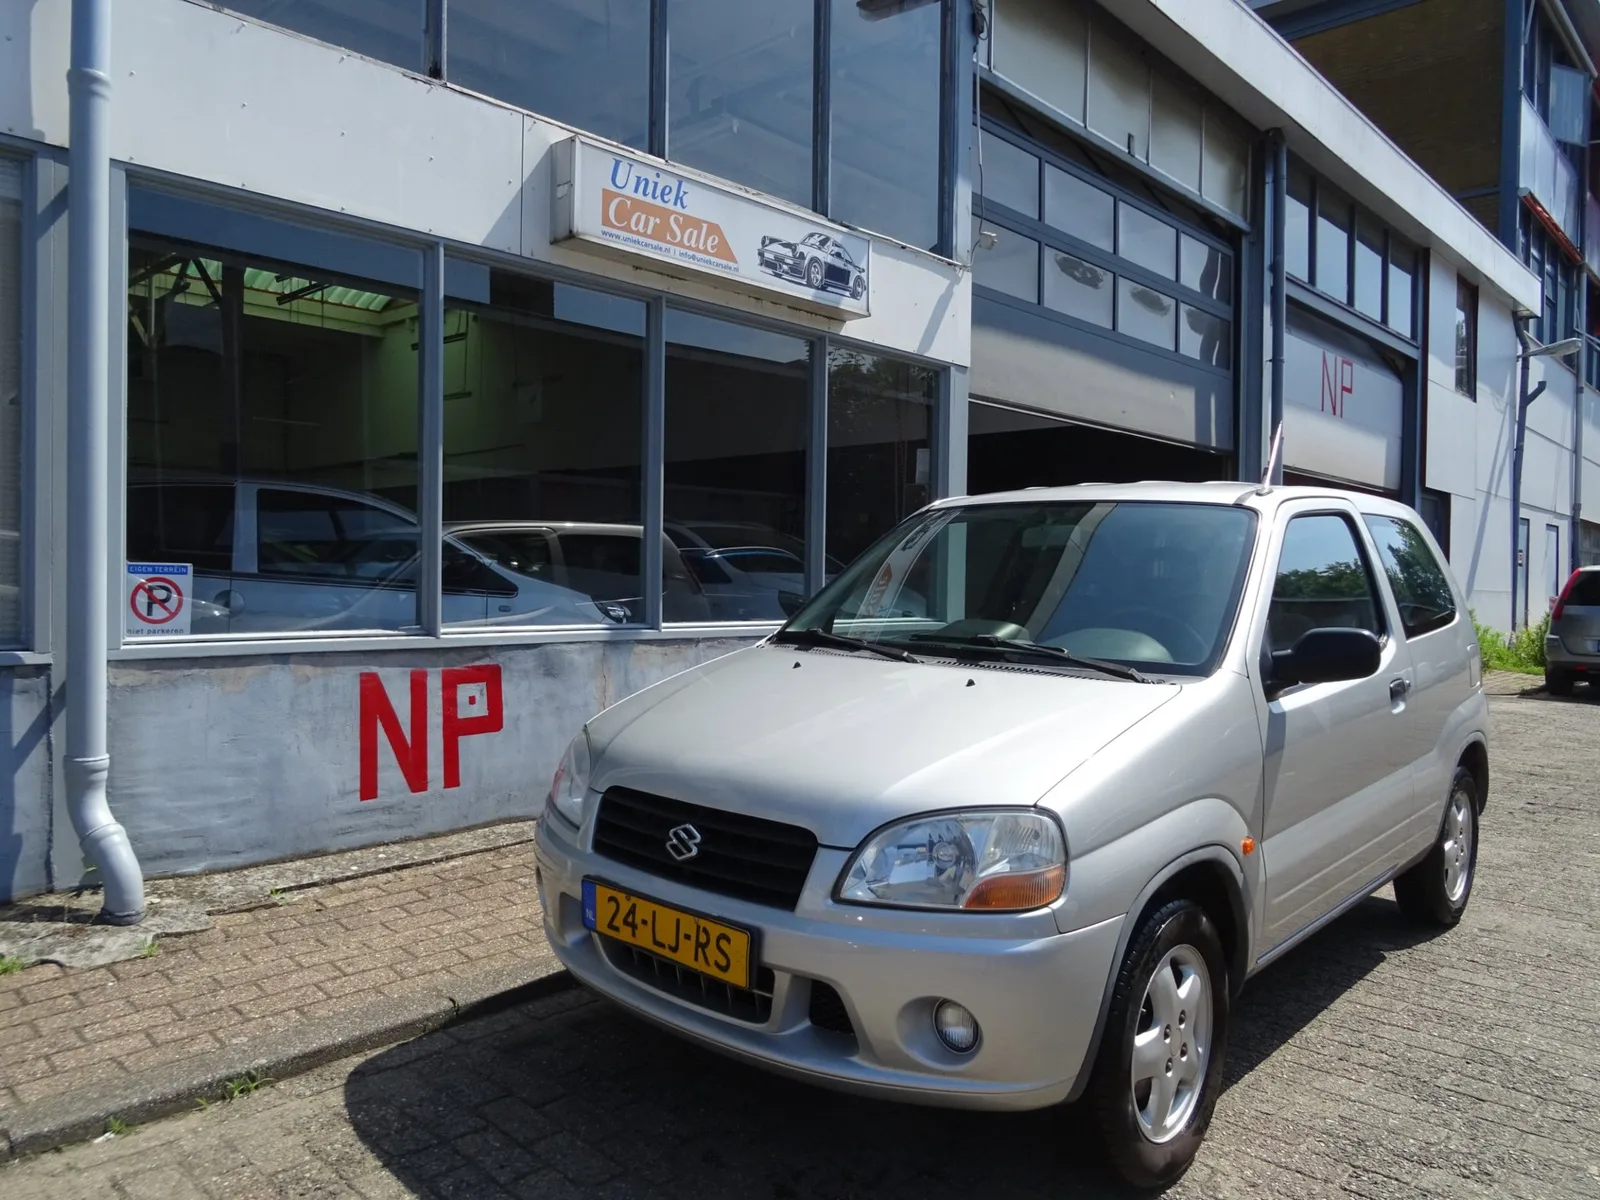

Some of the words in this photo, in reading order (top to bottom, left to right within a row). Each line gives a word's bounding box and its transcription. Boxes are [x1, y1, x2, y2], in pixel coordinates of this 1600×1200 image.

[610, 157, 689, 210] Uniek
[601, 229, 671, 254] www.uniekcarsale.nl
[678, 250, 740, 273] info@uniekcarsale.nl
[608, 197, 660, 235] Car
[666, 214, 719, 253] Sale
[1321, 351, 1354, 418] NP
[129, 565, 153, 573] EIGEN
[155, 566, 187, 574] TERREIN
[359, 664, 504, 802] NP
[606, 895, 732, 973] 24-LJ-RS
